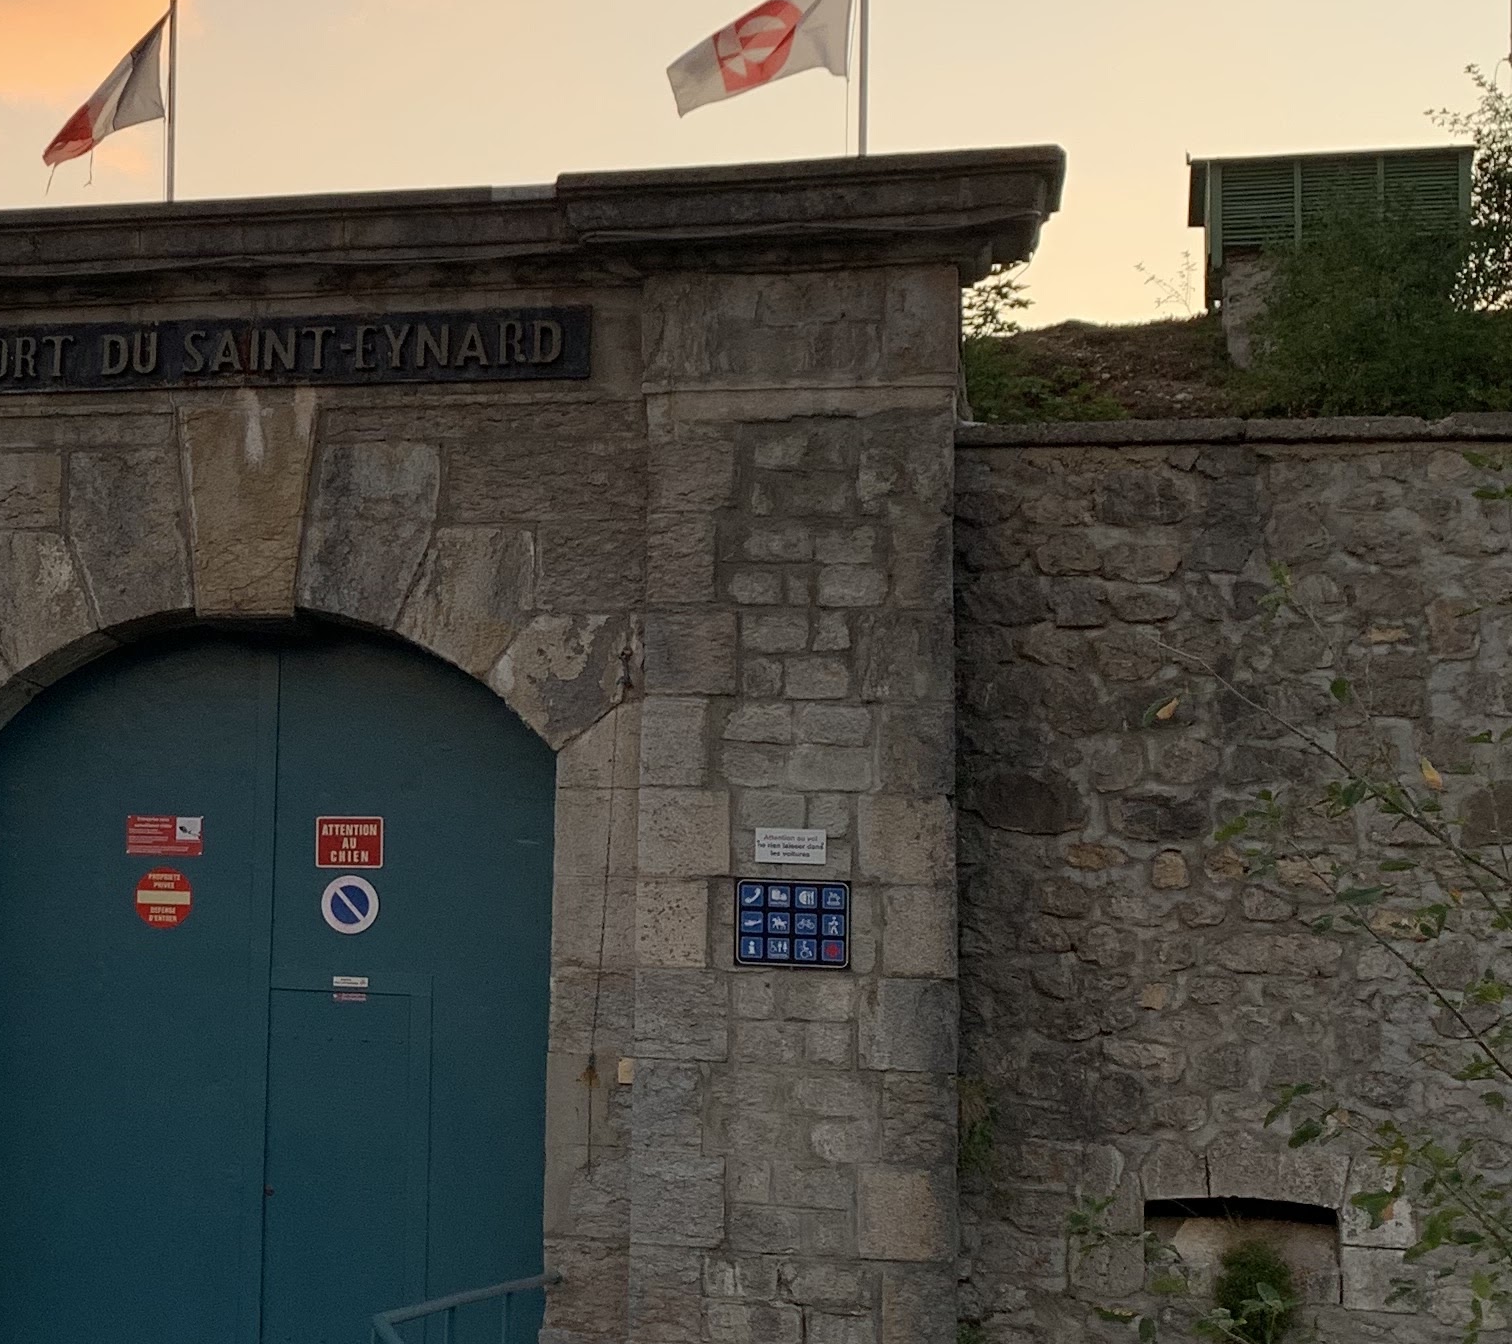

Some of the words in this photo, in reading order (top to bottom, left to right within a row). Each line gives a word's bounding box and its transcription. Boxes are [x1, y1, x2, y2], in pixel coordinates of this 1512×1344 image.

[100, 330, 158, 376] DU
[182, 319, 563, 374] SAINT-EYNARD
[322, 824, 377, 836] ATTENTION
[342, 837, 357, 849] AU
[330, 850, 369, 862] CHIEN
